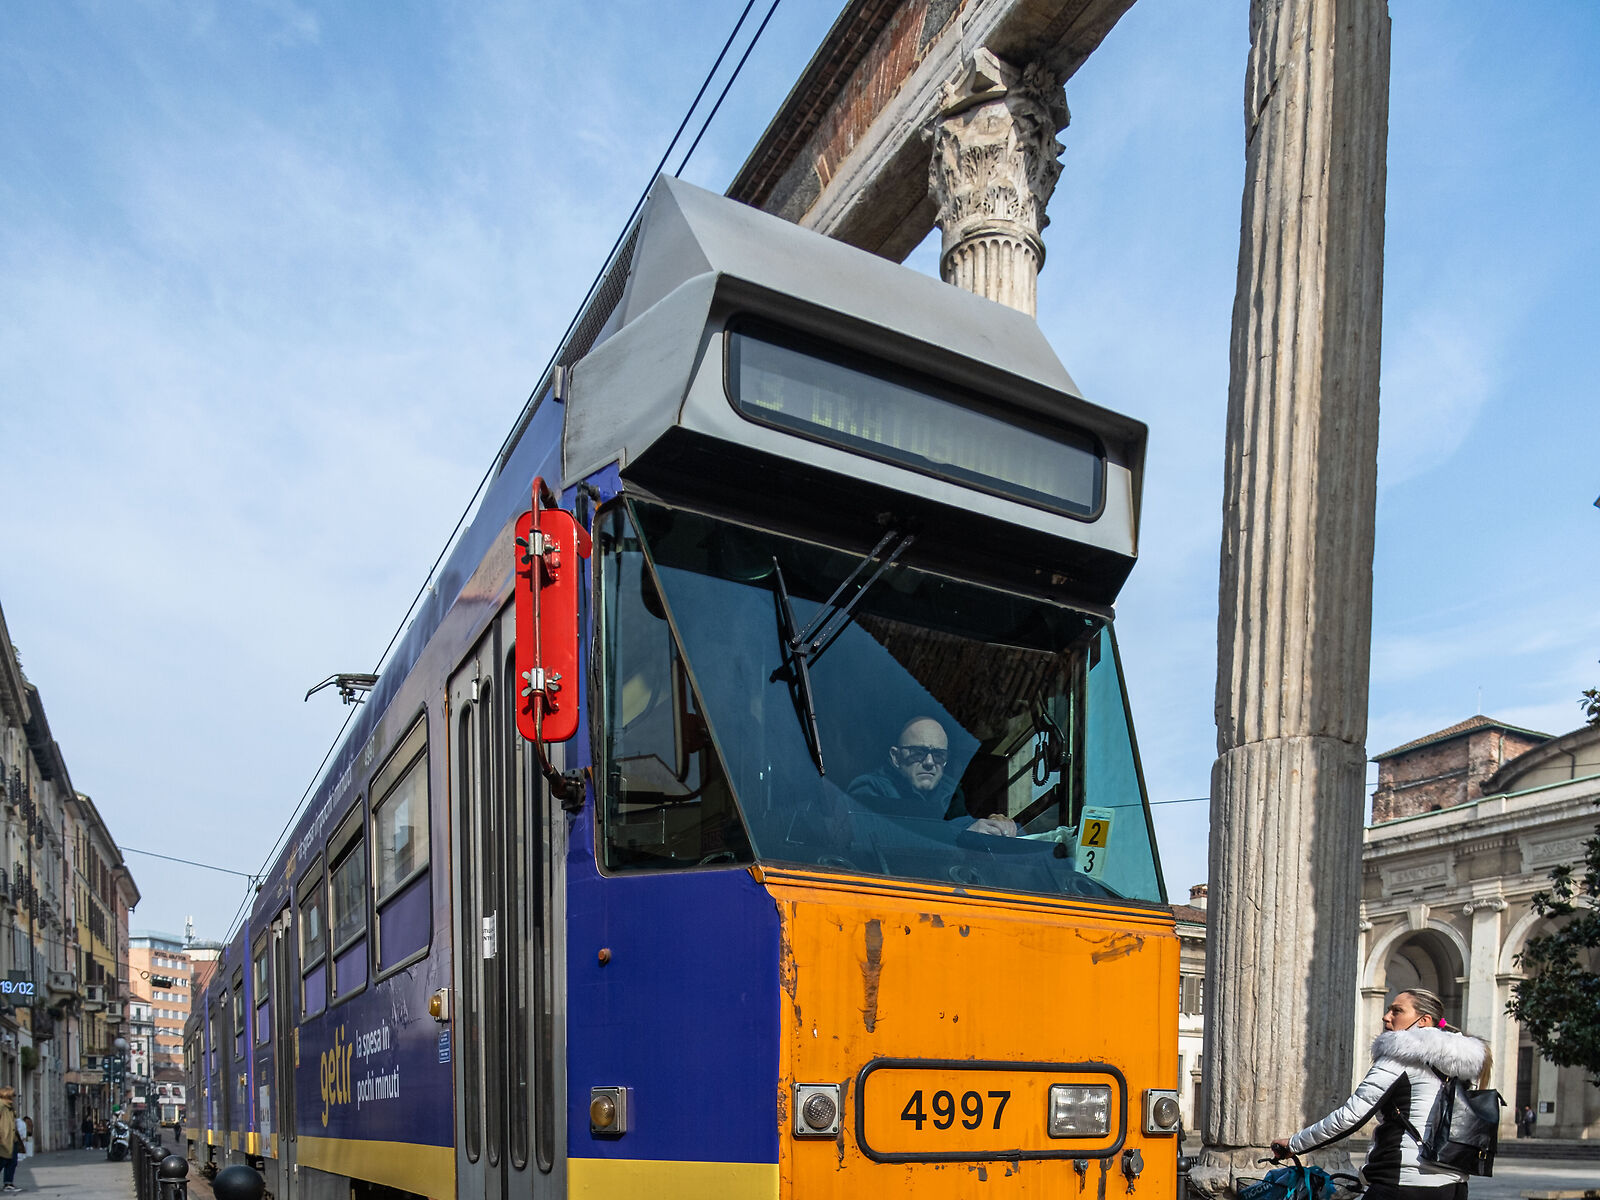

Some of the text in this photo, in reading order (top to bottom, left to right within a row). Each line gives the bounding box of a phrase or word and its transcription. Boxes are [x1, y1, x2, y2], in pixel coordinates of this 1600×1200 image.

[1088, 821, 1102, 846] 2
[1083, 850, 1096, 874] 3
[0, 980, 35, 995] 19/02
[355, 1018, 390, 1064] la spesa in
[320, 1023, 354, 1128] getir
[357, 1064, 400, 1111] pochi minuti
[900, 1089, 1011, 1131] 4997
